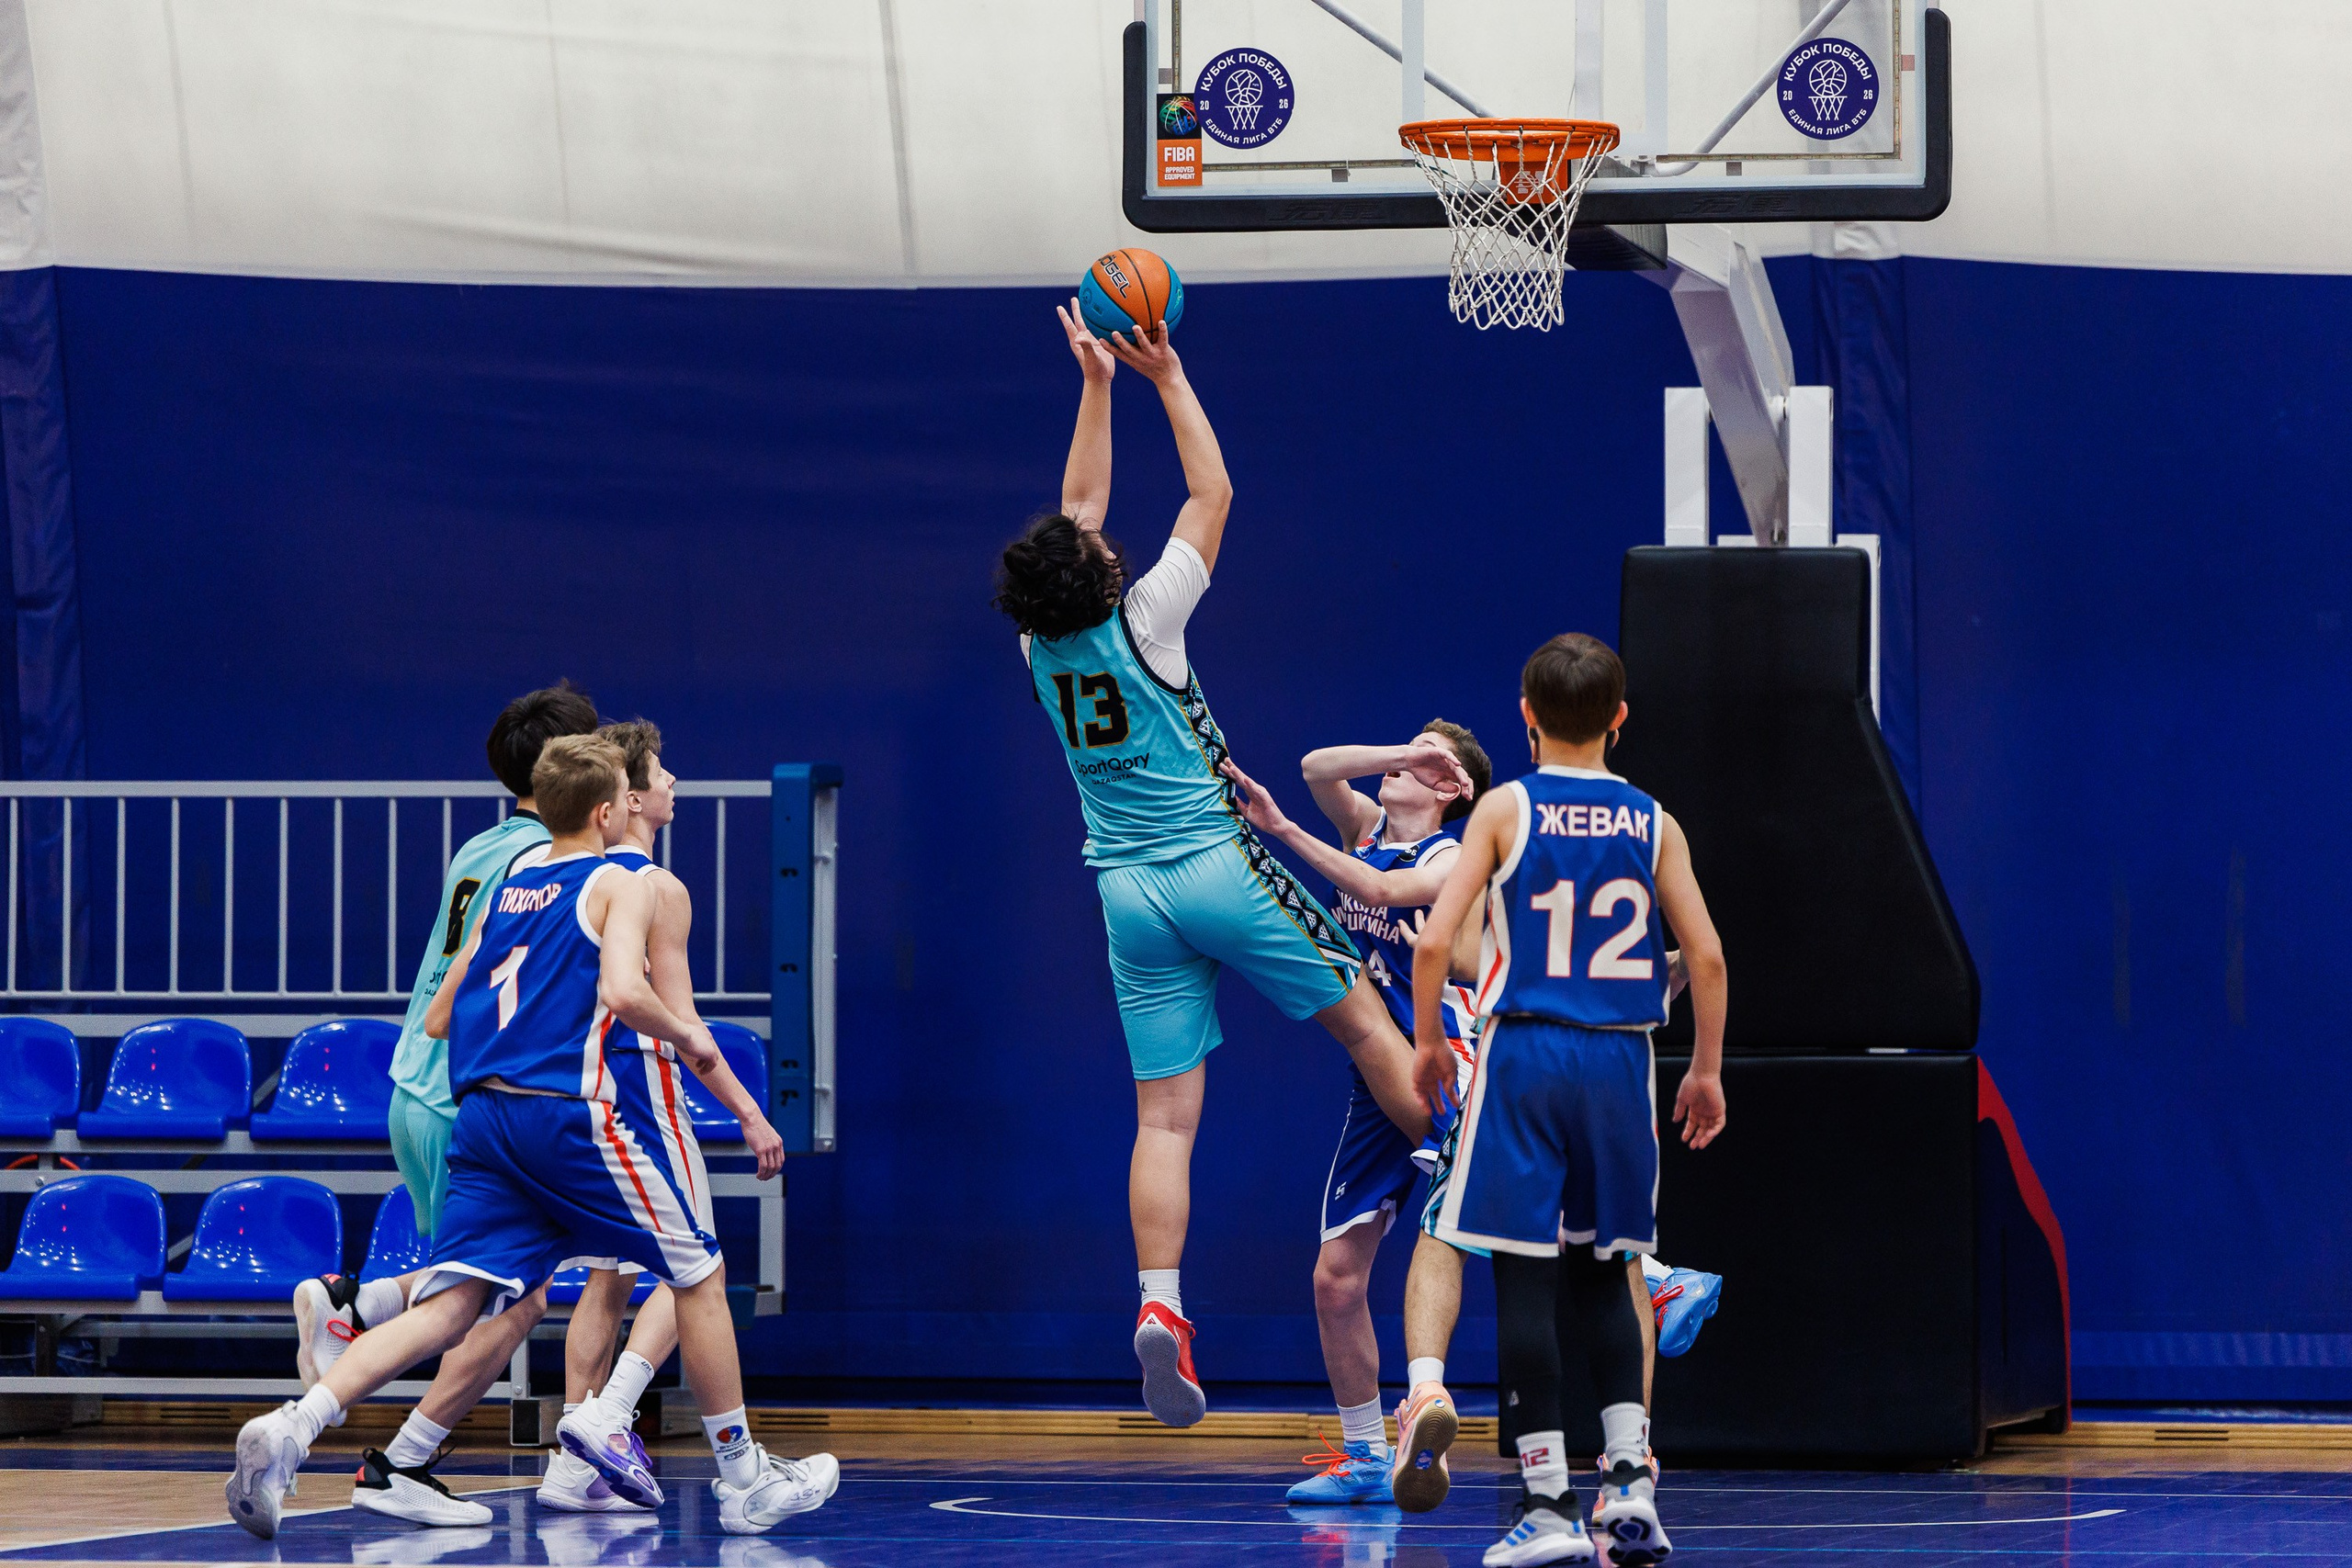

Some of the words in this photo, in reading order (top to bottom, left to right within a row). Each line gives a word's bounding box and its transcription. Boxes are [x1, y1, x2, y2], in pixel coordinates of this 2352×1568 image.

[1200, 54, 1236, 92] КУБОК
[1238, 53, 1287, 89] ПОБЕДЫ
[1783, 44, 1820, 82] КУБОК
[1823, 43, 1872, 80] ПОБЕДЫ
[1199, 100, 1210, 110] 20
[1278, 98, 1289, 109] 26
[1782, 90, 1792, 101] 20
[1863, 89, 1873, 100] 26
[1204, 118, 1240, 144] ЕДИНАЯ
[1242, 132, 1268, 144] ЛИГА
[1267, 118, 1283, 135] ВТБ
[1788, 108, 1823, 135] ЕДИНАЯ
[1826, 123, 1851, 135] ЛИГА
[1851, 108, 1867, 126] ВТБ
[1164, 146, 1195, 162] FIBA
[1050, 671, 1130, 750] 13
[1075, 752, 1150, 777] SportQory
[1530, 877, 1654, 979] 12
[489, 944, 530, 1032] 1
[1521, 1448, 1550, 1468] 12
